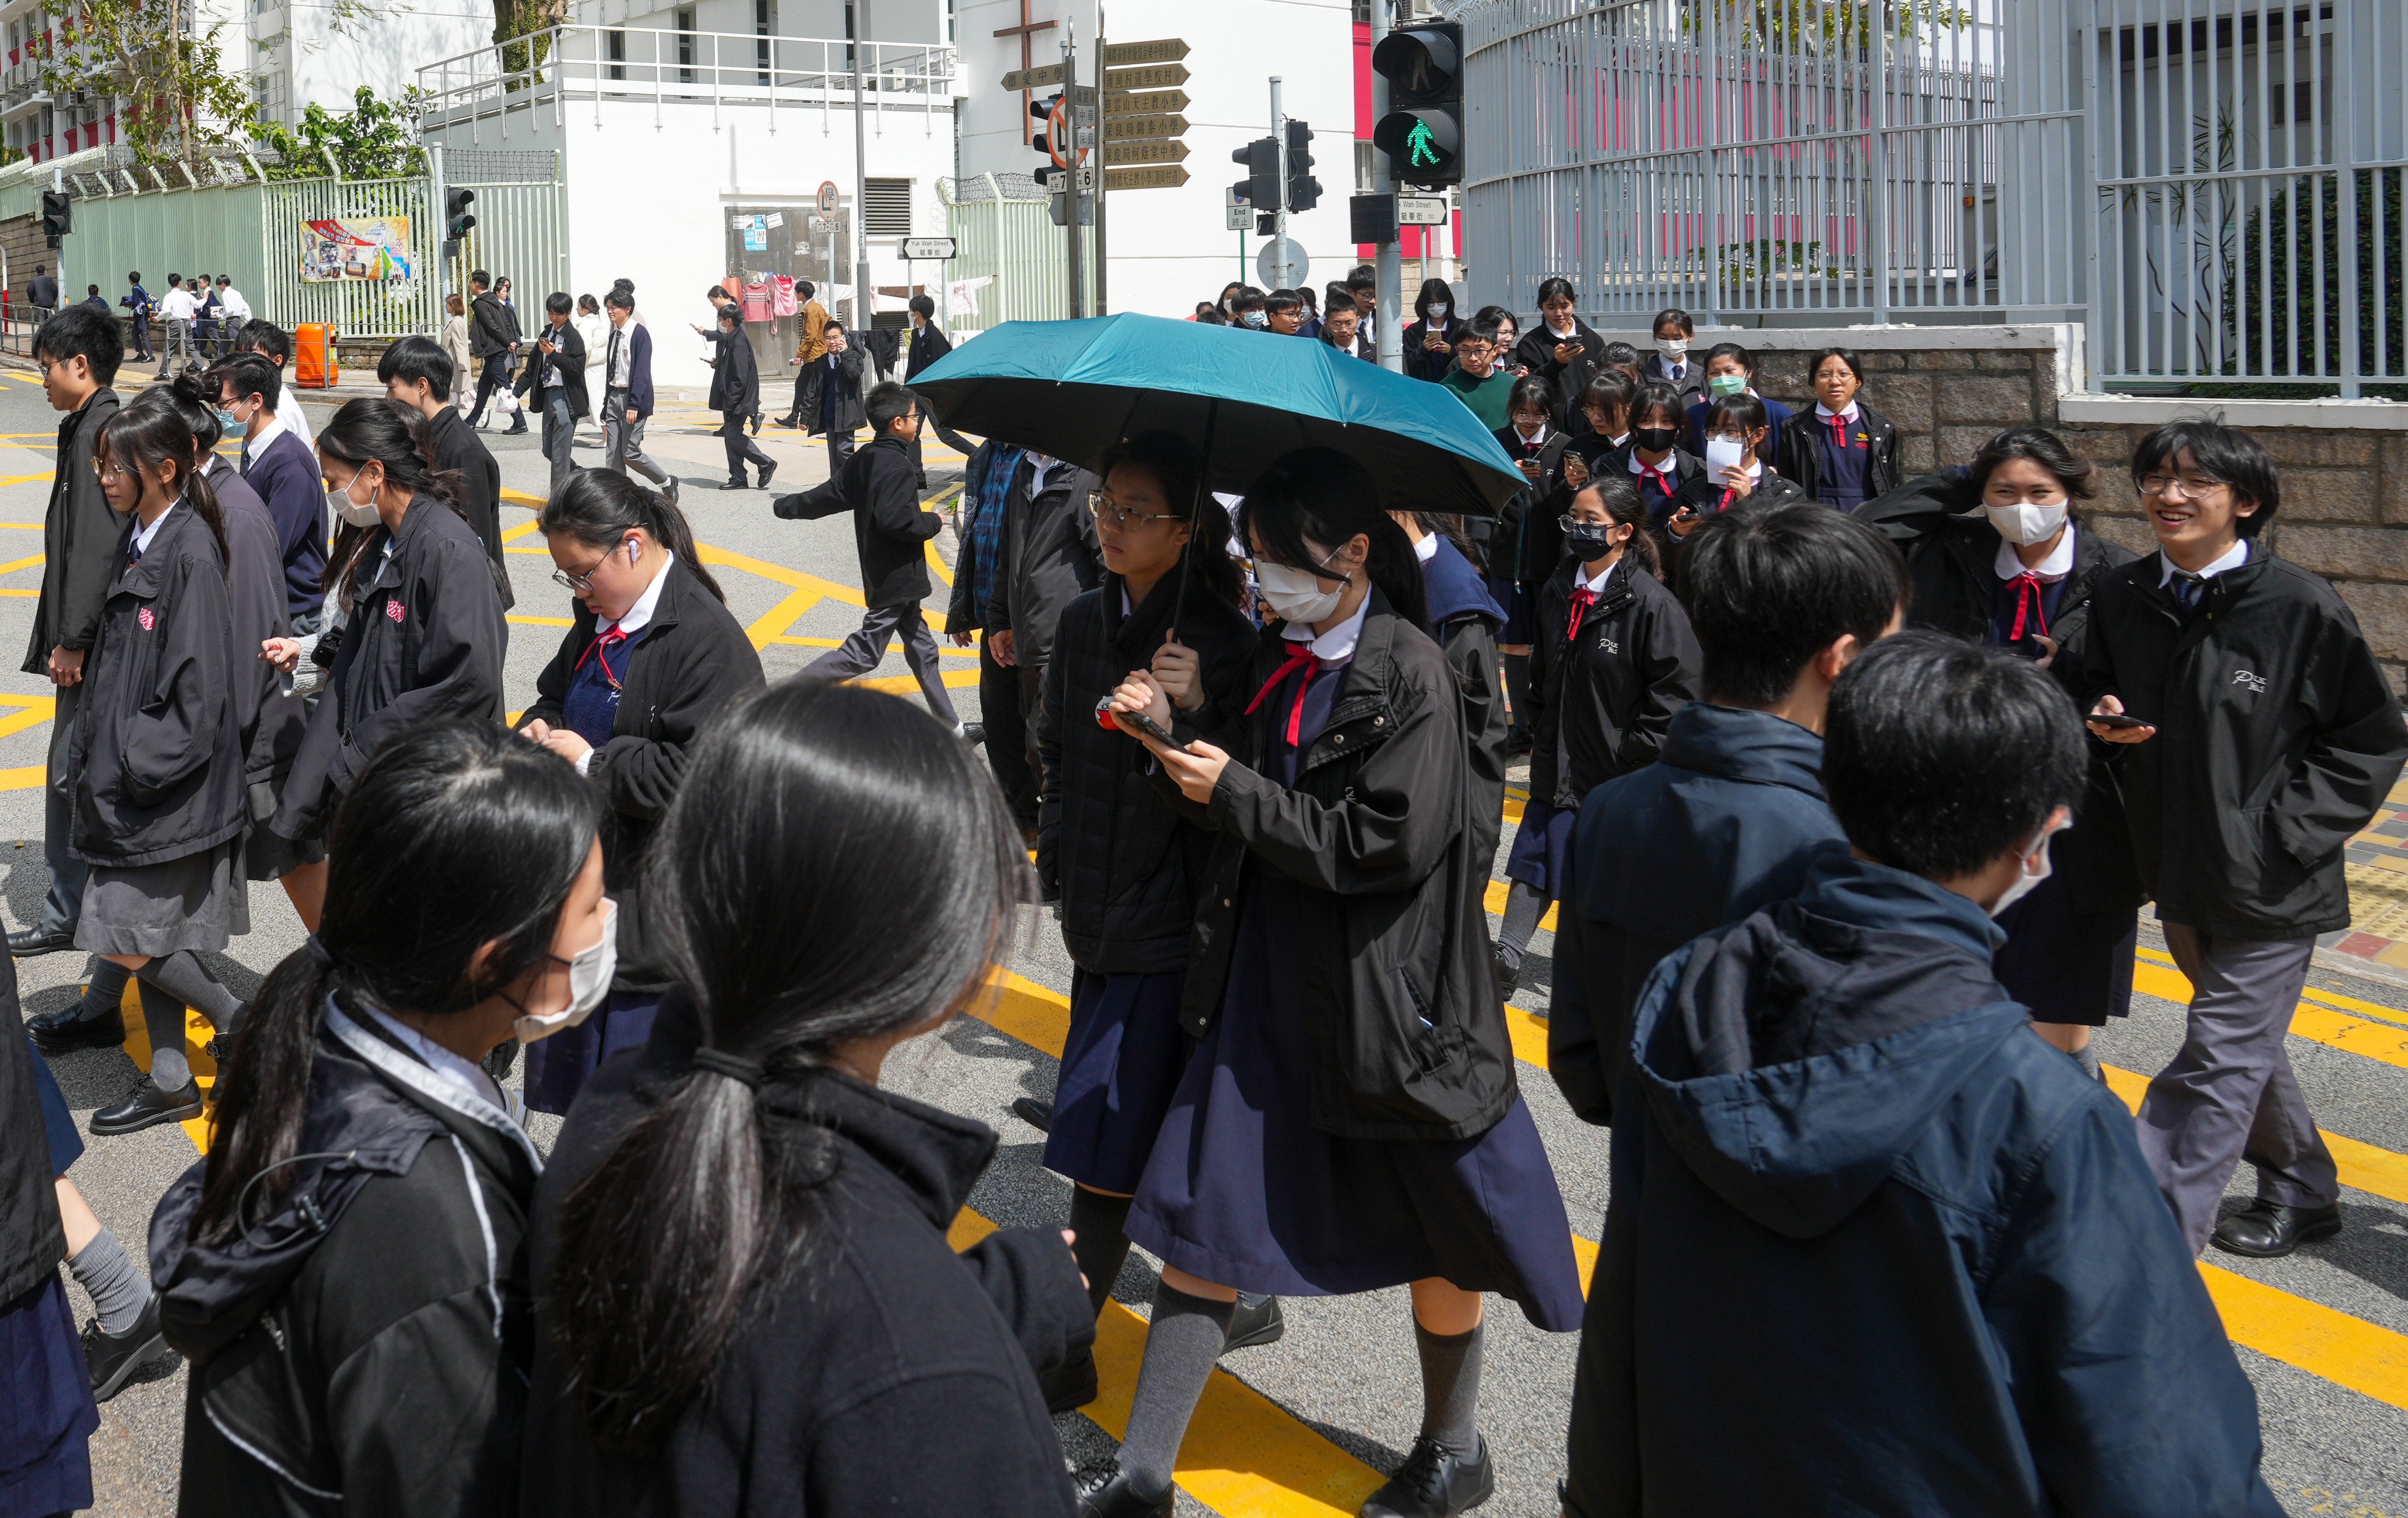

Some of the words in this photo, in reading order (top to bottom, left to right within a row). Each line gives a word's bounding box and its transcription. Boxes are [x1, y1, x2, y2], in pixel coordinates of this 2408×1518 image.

[1008, 66, 1063, 87] 德愛中學
[1106, 68, 1171, 88] 蒲崗村道學校村
[1105, 93, 1179, 113] 慈雲山天主教小學
[1105, 118, 1178, 138] 保良局錦泰小學
[1105, 143, 1178, 162] 保良局何蔭棠中學
[1060, 175, 1066, 189] 7
[1084, 171, 1091, 186] 6
[823, 223, 826, 231] 7
[1232, 218, 1248, 226] 終止
